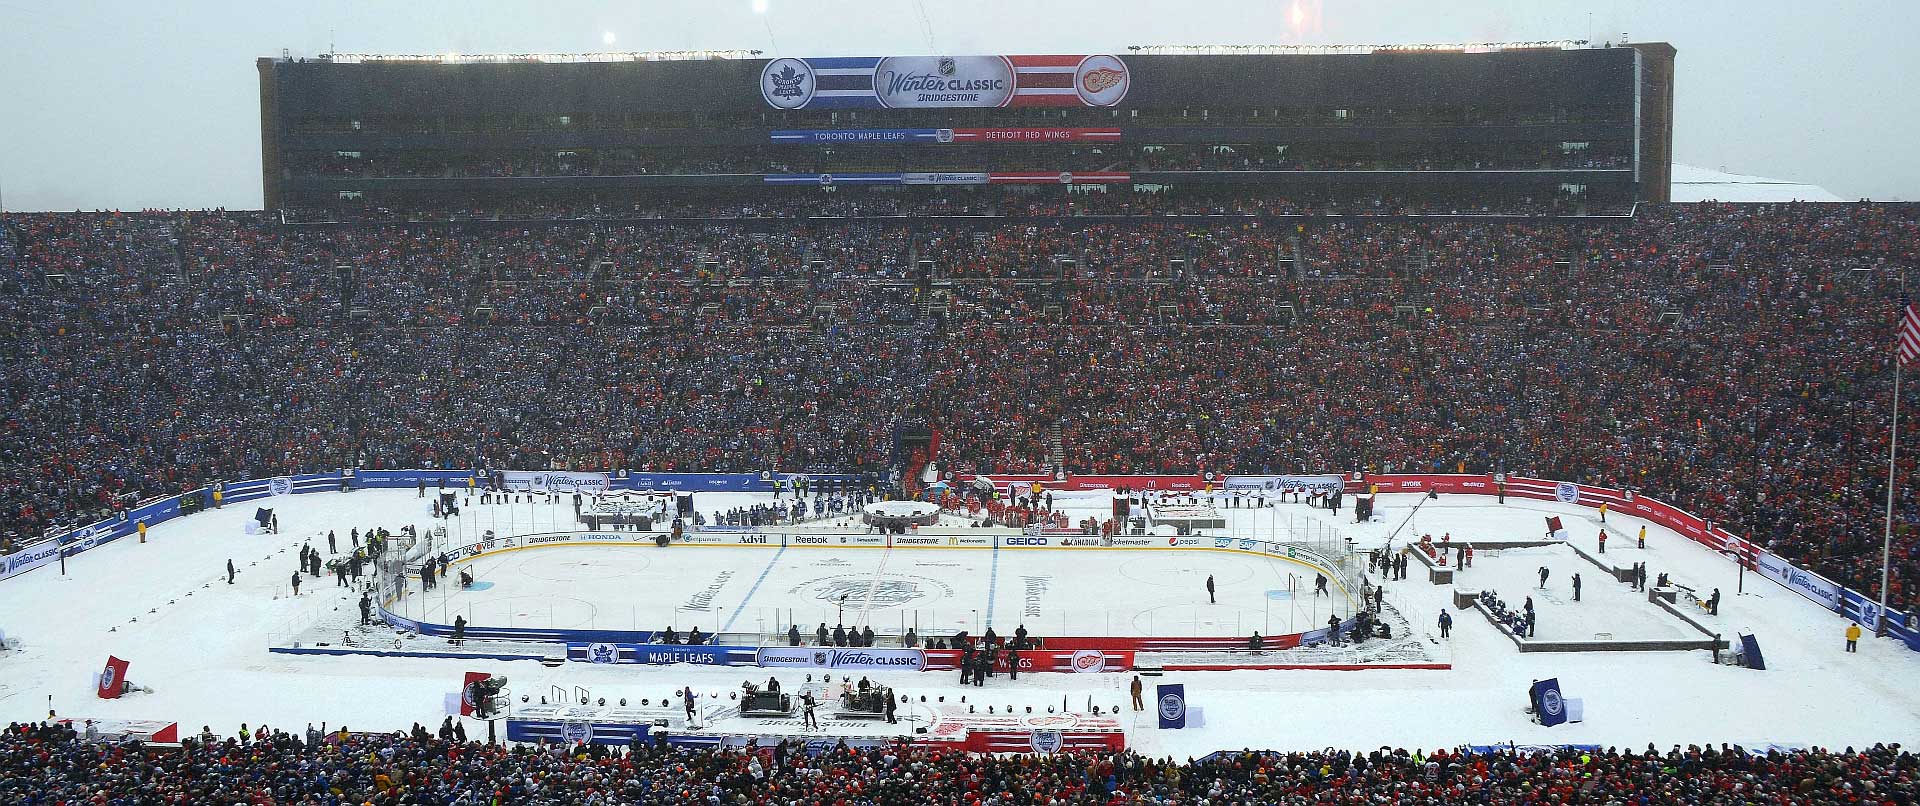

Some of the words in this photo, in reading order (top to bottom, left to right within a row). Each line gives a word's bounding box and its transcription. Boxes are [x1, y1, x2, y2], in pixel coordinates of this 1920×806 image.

[883, 71, 947, 97] Winter
[947, 79, 1003, 91] CLASSIC
[917, 93, 979, 102] BRIDGESTONE
[814, 132, 855, 141] TORONTO
[858, 132, 881, 140] MAPLE
[883, 131, 905, 140] LEAFS
[986, 131, 1021, 139] DETROIT
[1025, 131, 1040, 139] RED
[1044, 131, 1071, 139] WINGS
[544, 473, 577, 487] Winter
[528, 535, 571, 544] BRIDGESTONE
[738, 534, 767, 543] Advil
[795, 535, 828, 544] Reebok
[896, 537, 940, 545] BRIDGESTONE
[1006, 537, 1048, 546] GEICO
[1071, 538, 1099, 546] CANADIAN
[1215, 539, 1229, 548] SAP
[1240, 541, 1254, 550] SAP
[462, 541, 496, 556] DISCOVER
[7, 552, 34, 574] Winter
[34, 547, 59, 562] CLASSIC
[1788, 566, 1811, 592] Winter
[1811, 585, 1833, 601] CLASSIC
[649, 653, 680, 663] MAPLE
[684, 654, 713, 664] LEAFS
[763, 655, 809, 663] BRIDGESTONE
[827, 650, 876, 668] Winter
[875, 656, 917, 666] CLASSIC
